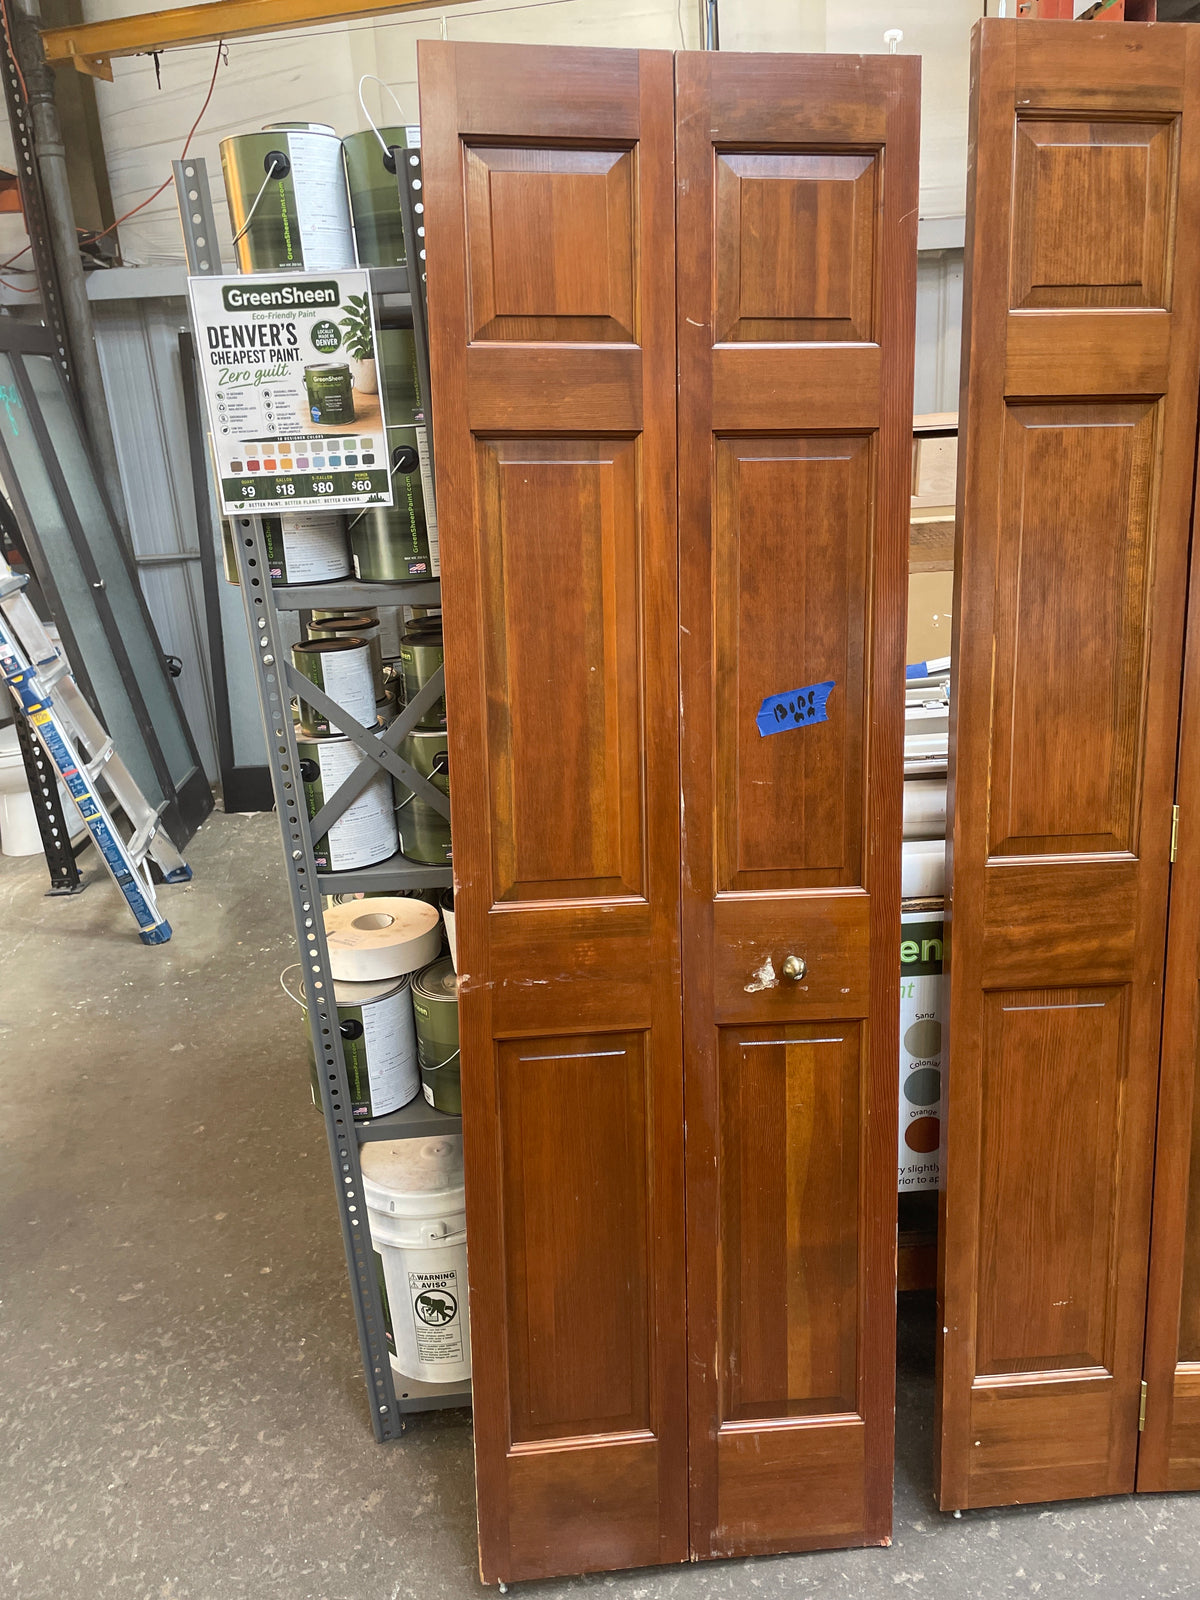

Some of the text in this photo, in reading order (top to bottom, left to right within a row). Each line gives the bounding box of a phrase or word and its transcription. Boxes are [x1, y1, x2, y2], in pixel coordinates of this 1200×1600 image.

[279, 182, 293, 260] GreenSheenPaint.com
[228, 287, 335, 306] GreenSheen
[252, 312, 296, 320] Eco-Friendly
[207, 323, 298, 349] DENVER’S
[315, 338, 338, 347] DENVER
[211, 348, 303, 365] CHEAPEST PAINT.
[219, 363, 291, 386] Zero guilt.
[275, 484, 295, 495] $18
[312, 482, 334, 493] $80
[351, 480, 372, 491] $60
[241, 486, 256, 497] $9
[915, 1012, 935, 1020] Sand
[909, 1060, 941, 1070] Colonial
[910, 1109, 938, 1118] Orange
[917, 1177, 926, 1185] to
[416, 1272, 455, 1281] WARNING
[421, 1281, 447, 1289] AVISO
